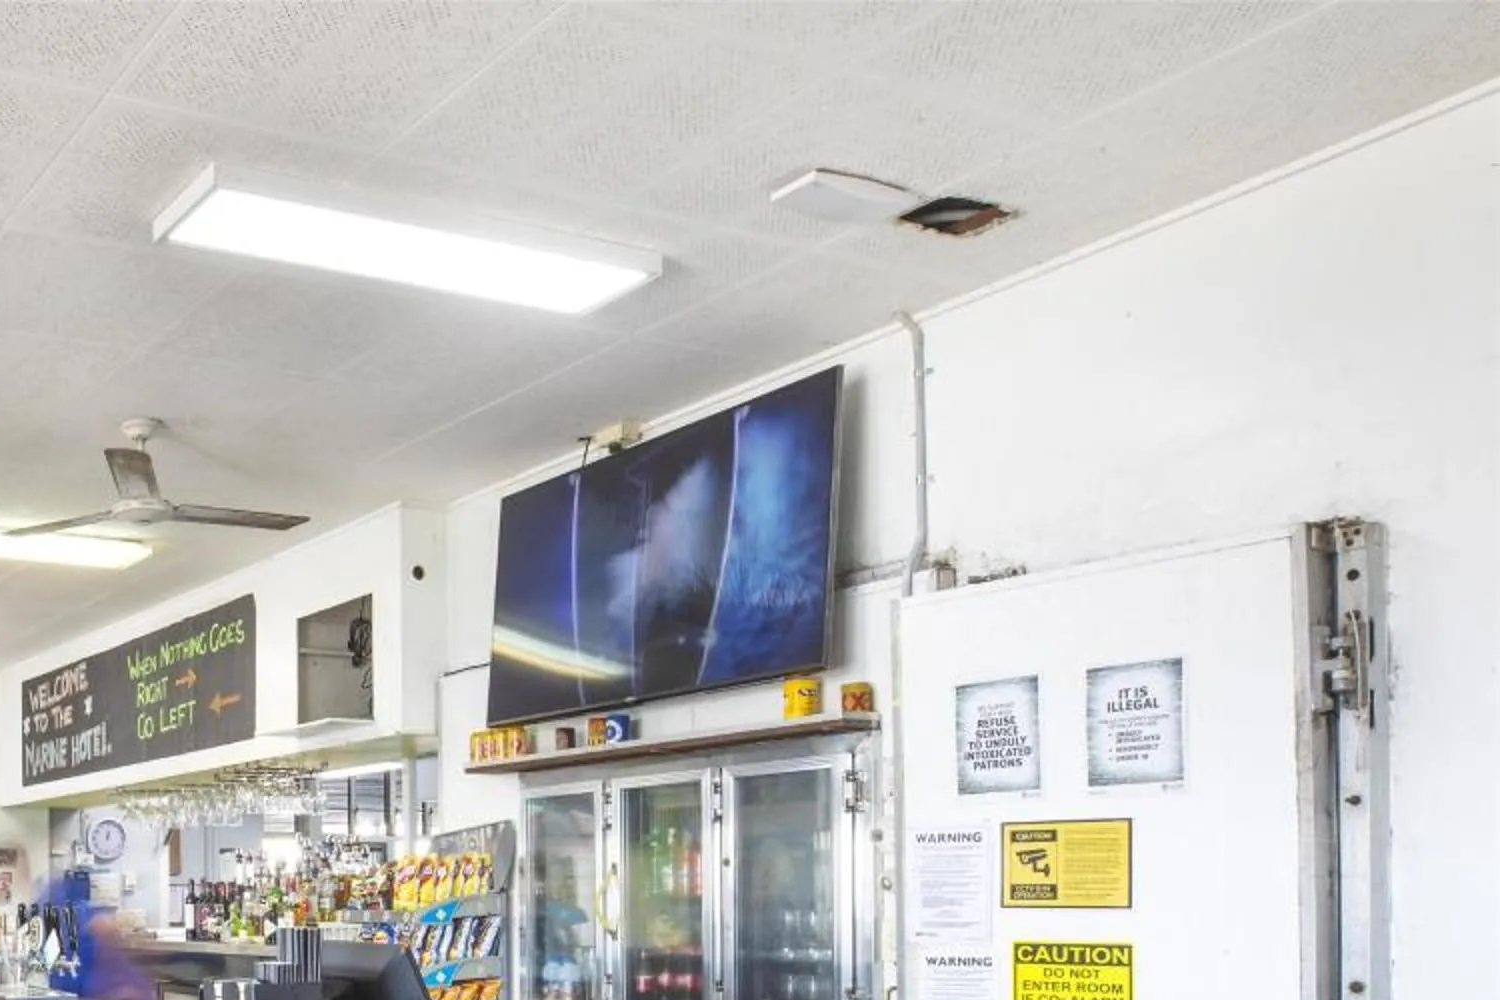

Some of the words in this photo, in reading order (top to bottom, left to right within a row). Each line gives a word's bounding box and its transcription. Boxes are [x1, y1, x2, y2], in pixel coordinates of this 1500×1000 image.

[160, 631, 207, 668] NOTHING
[29, 661, 89, 712] WELCOME
[1118, 687, 1131, 699] IT
[1134, 686, 1148, 699] IS
[1107, 698, 1161, 714] ILLEGAL
[33, 712, 49, 733] TO
[51, 704, 73, 729] THE
[159, 699, 197, 733] LEFT
[977, 716, 1017, 729] REFUSE
[975, 725, 1019, 739] SERVICE
[25, 737, 67, 777] MARINE
[71, 719, 107, 768] HOTEL
[968, 740, 983, 751] TO
[985, 735, 1027, 749] UNDULY
[963, 745, 1033, 761] INTOXICATED
[973, 757, 1024, 771] PATRONS
[915, 831, 982, 844] WARNING
[925, 956, 993, 967] WARNING
[1017, 944, 1129, 965] CAUTION
[1043, 967, 1065, 978] DO
[1069, 968, 1101, 980] NOT
[1023, 980, 1071, 992] ENTER
[1076, 982, 1124, 996] ROOM
